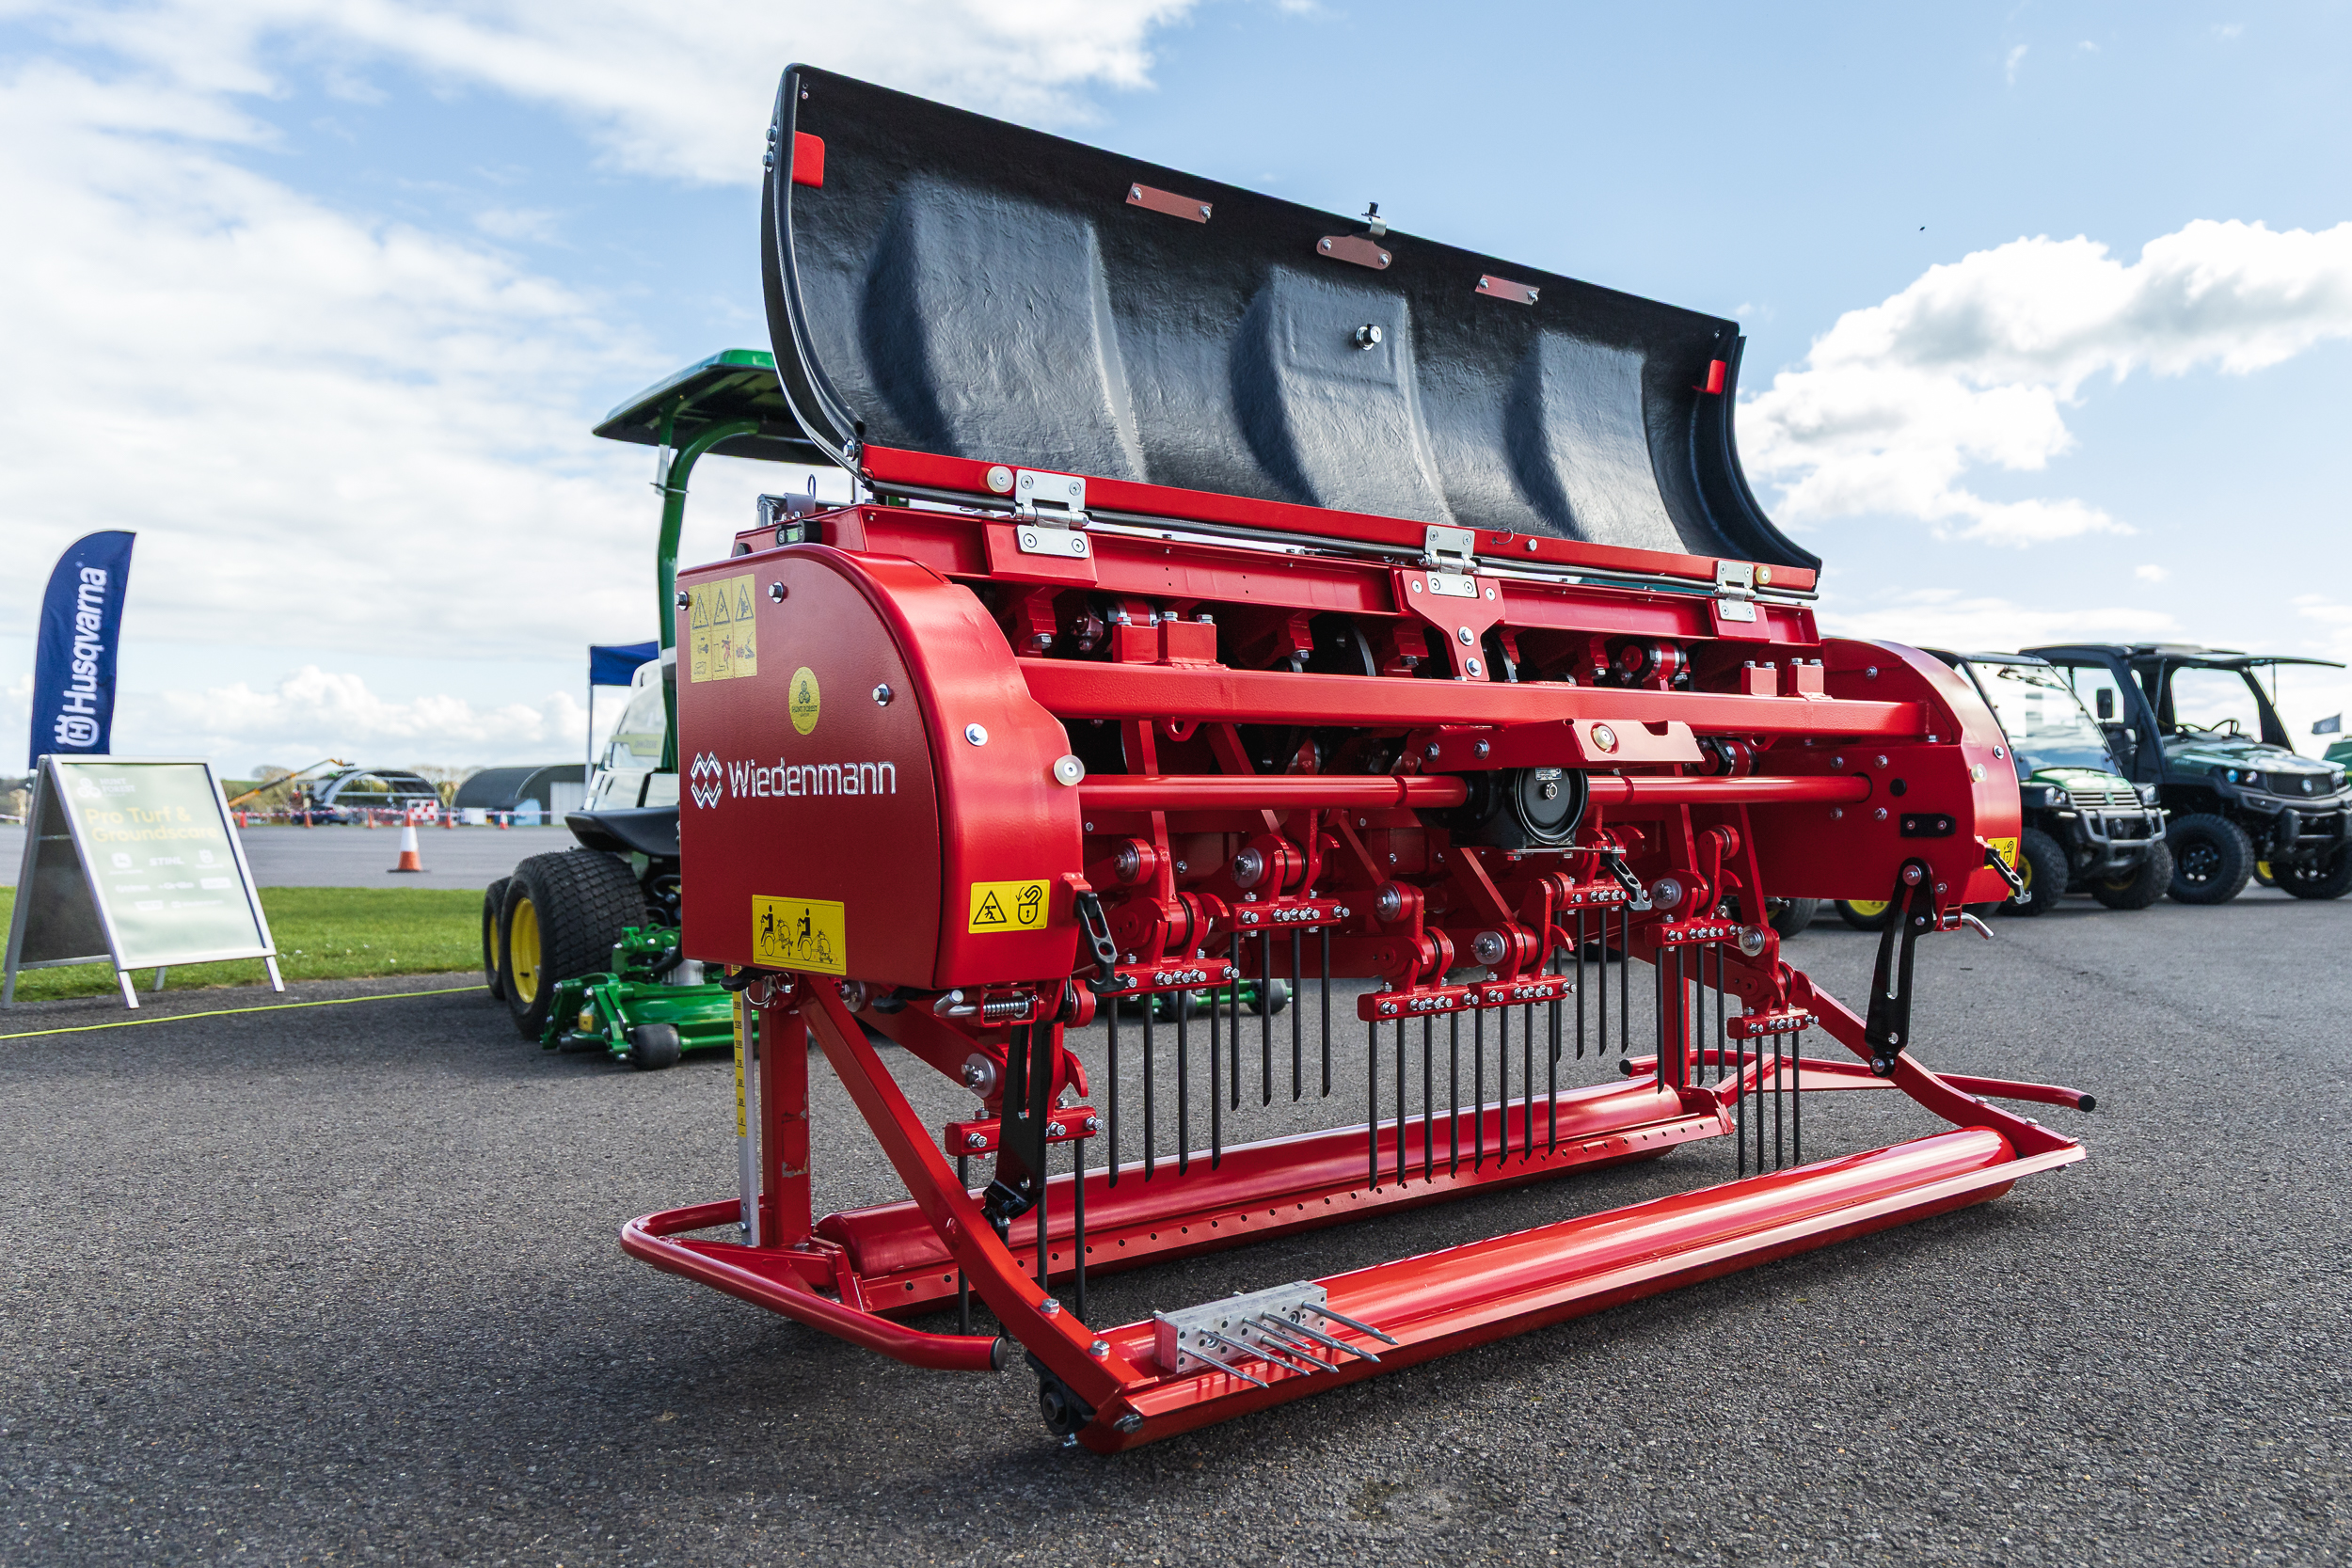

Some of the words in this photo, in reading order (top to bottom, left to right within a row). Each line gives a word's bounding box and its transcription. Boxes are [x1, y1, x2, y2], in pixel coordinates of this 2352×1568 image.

[62, 566, 108, 715] Husqvarna
[727, 757, 896, 799] Wiedenmann
[84, 808, 124, 825] Pro
[126, 806, 172, 823] Turf
[176, 806, 192, 822] &
[91, 825, 219, 843] Groundscare
[149, 856, 186, 866] STIHL
